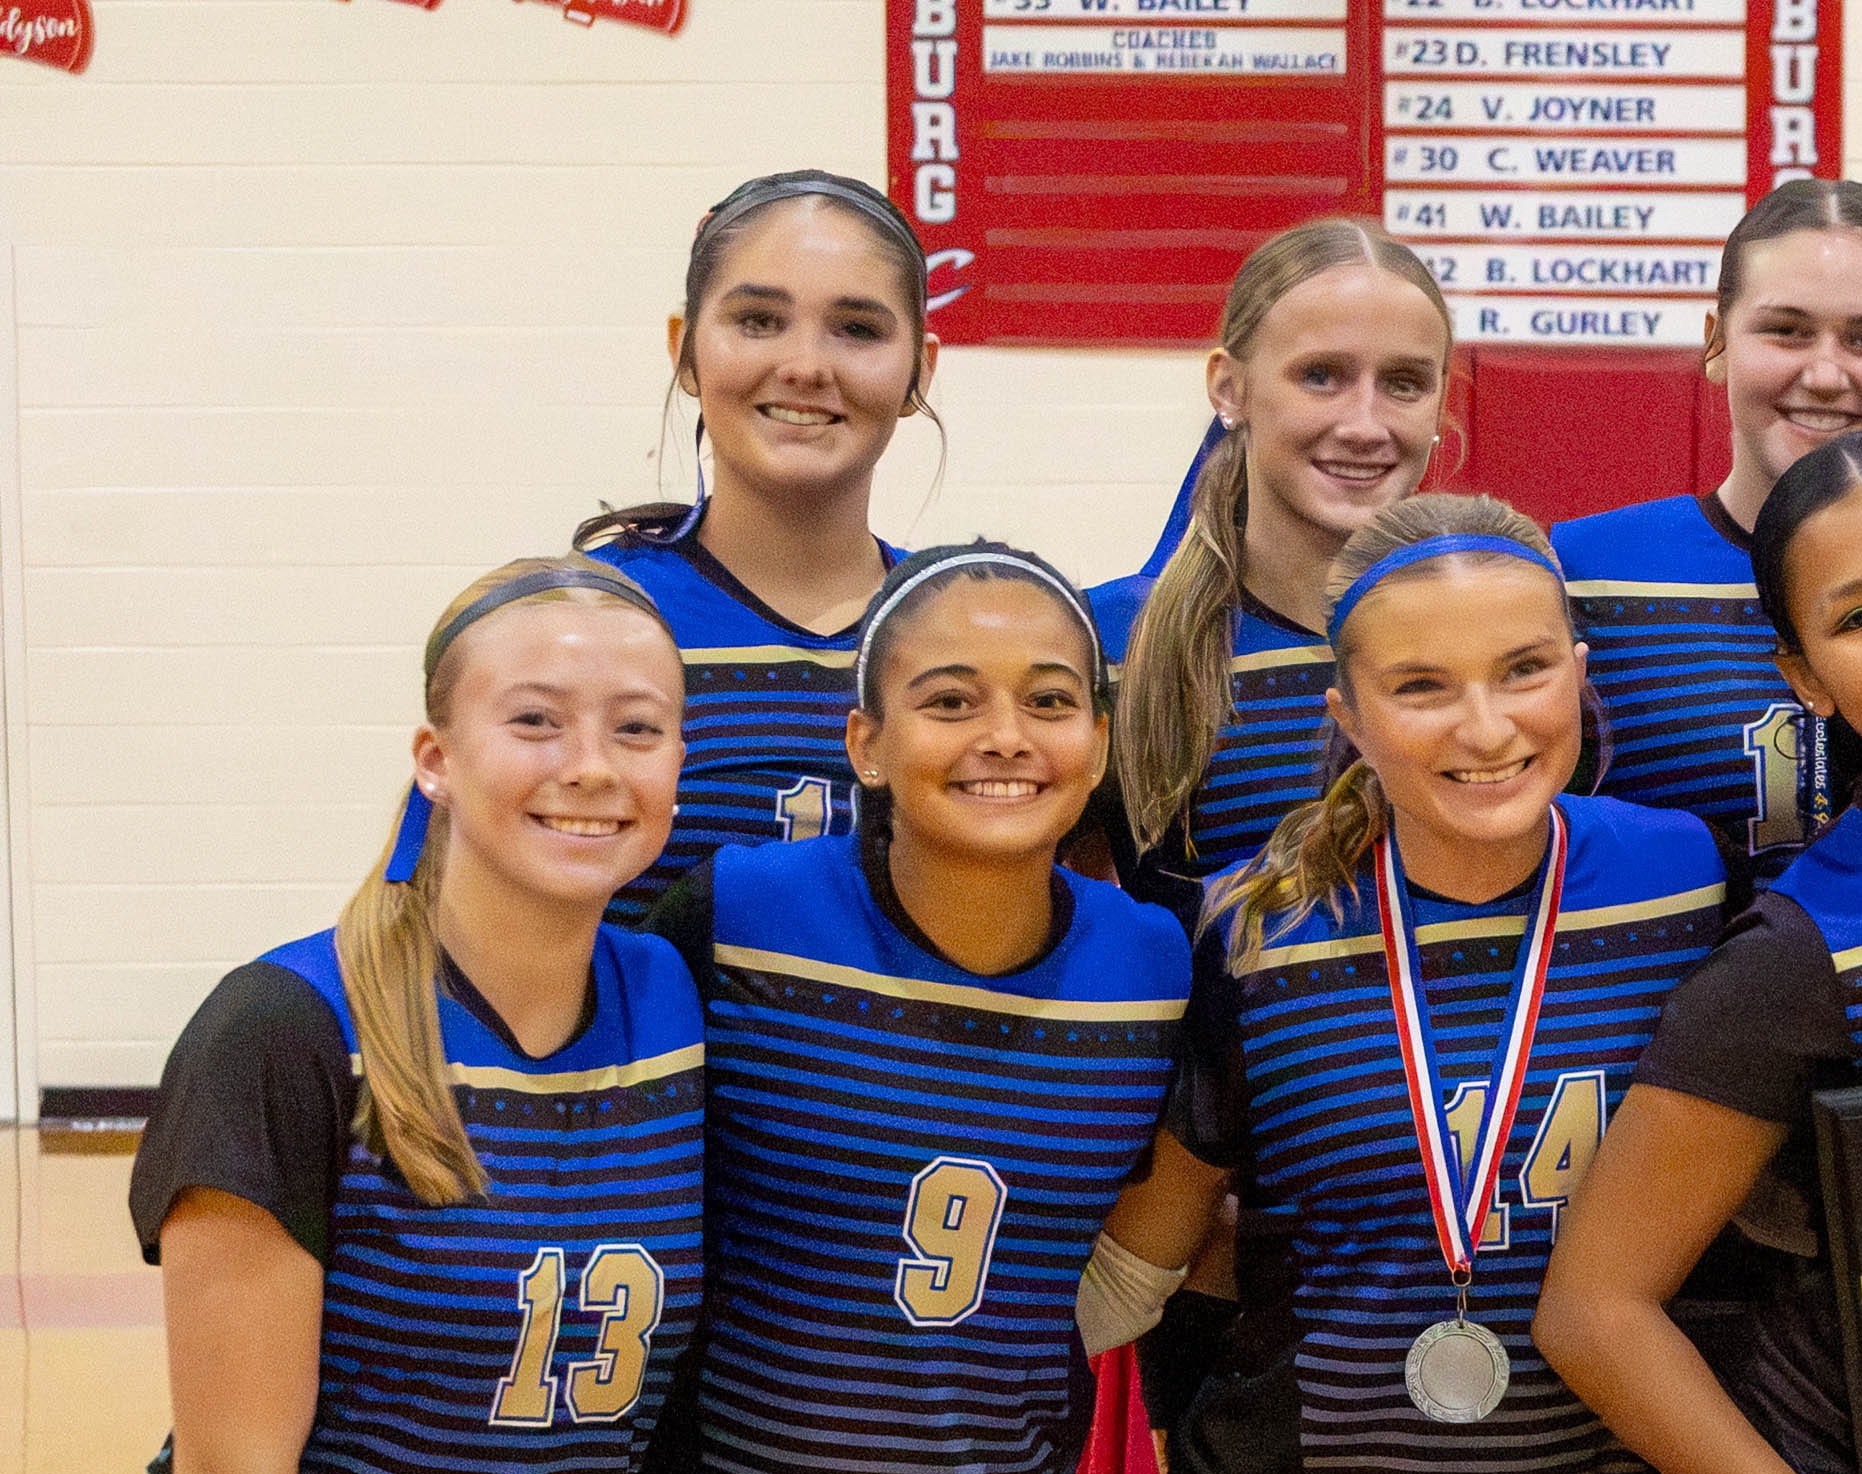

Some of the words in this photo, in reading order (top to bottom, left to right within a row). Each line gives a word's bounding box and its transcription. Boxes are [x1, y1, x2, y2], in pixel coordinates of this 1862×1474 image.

[1455, 42, 1488, 67] D.
[1504, 41, 1672, 67] FRENSLEY
[1481, 97, 1512, 121] V.
[1528, 97, 1657, 122] JOYNER
[1487, 148, 1519, 174] C.
[1535, 149, 1676, 174] WEAVER
[1480, 205, 1521, 230] W.
[1538, 206, 1655, 231] BAILEY
[1486, 258, 1517, 283] B.
[1532, 259, 1714, 285] LOCKHART
[1479, 308, 1511, 334] R.
[1531, 310, 1663, 336] GURLEY
[894, 1155, 1008, 1328] 9
[488, 1243, 665, 1427] 13
